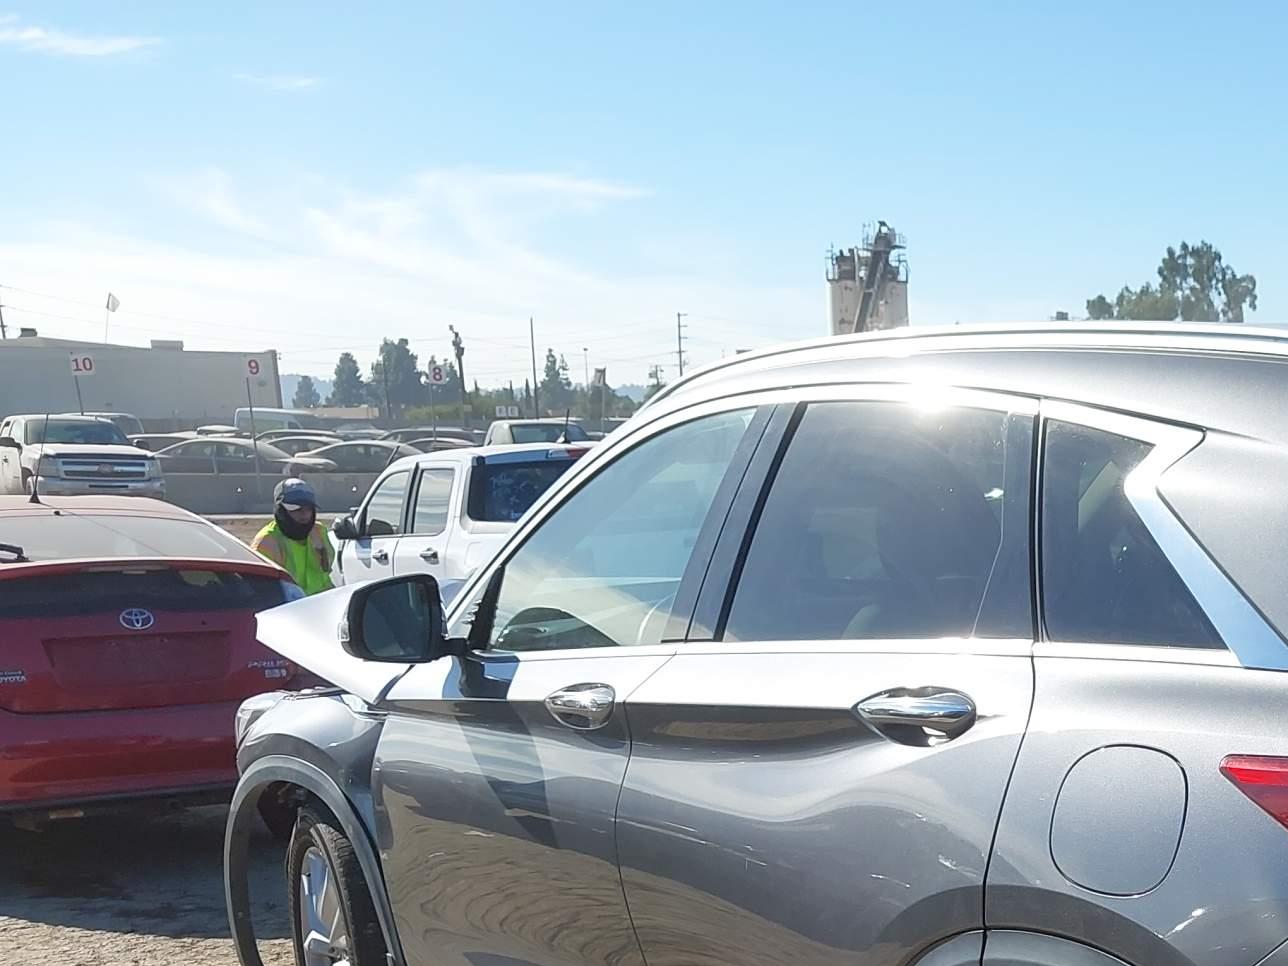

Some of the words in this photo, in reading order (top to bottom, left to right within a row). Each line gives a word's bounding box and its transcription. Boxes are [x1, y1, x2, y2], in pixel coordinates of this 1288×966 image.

[72, 357, 93, 372] 10
[248, 359, 260, 375] 9
[432, 367, 443, 382] 8
